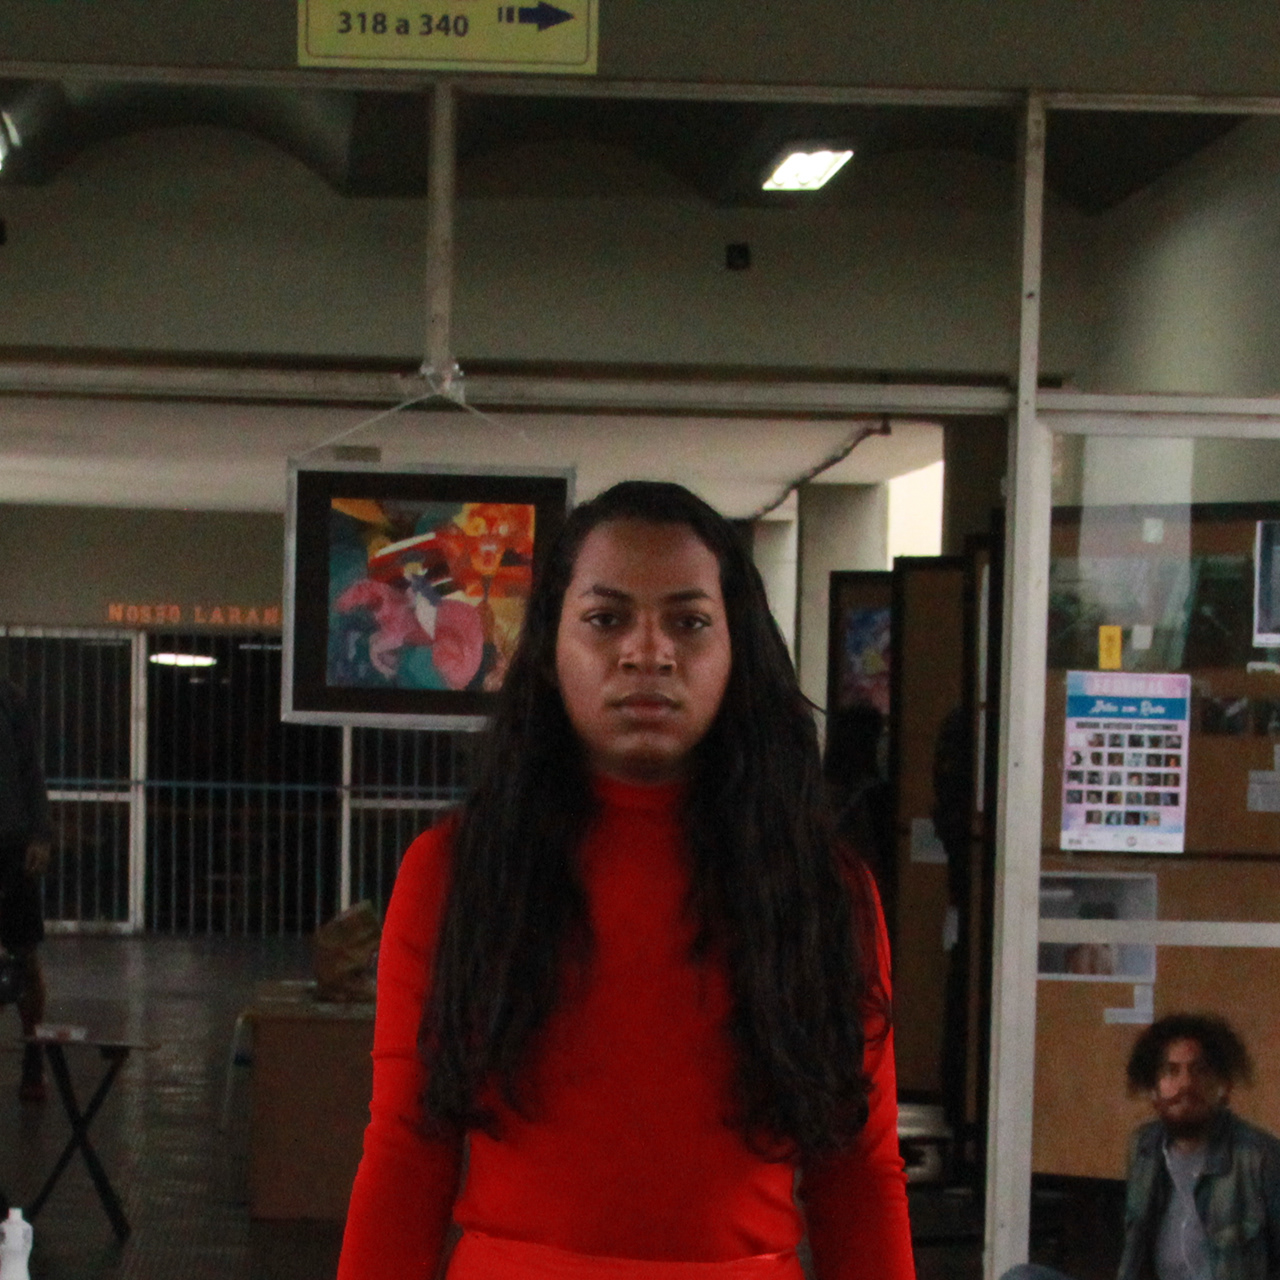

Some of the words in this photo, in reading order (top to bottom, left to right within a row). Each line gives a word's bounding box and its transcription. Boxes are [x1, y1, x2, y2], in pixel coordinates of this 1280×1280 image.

[337, 11, 388, 34] 318
[395, 16, 411, 35] a
[419, 13, 470, 37] 340
